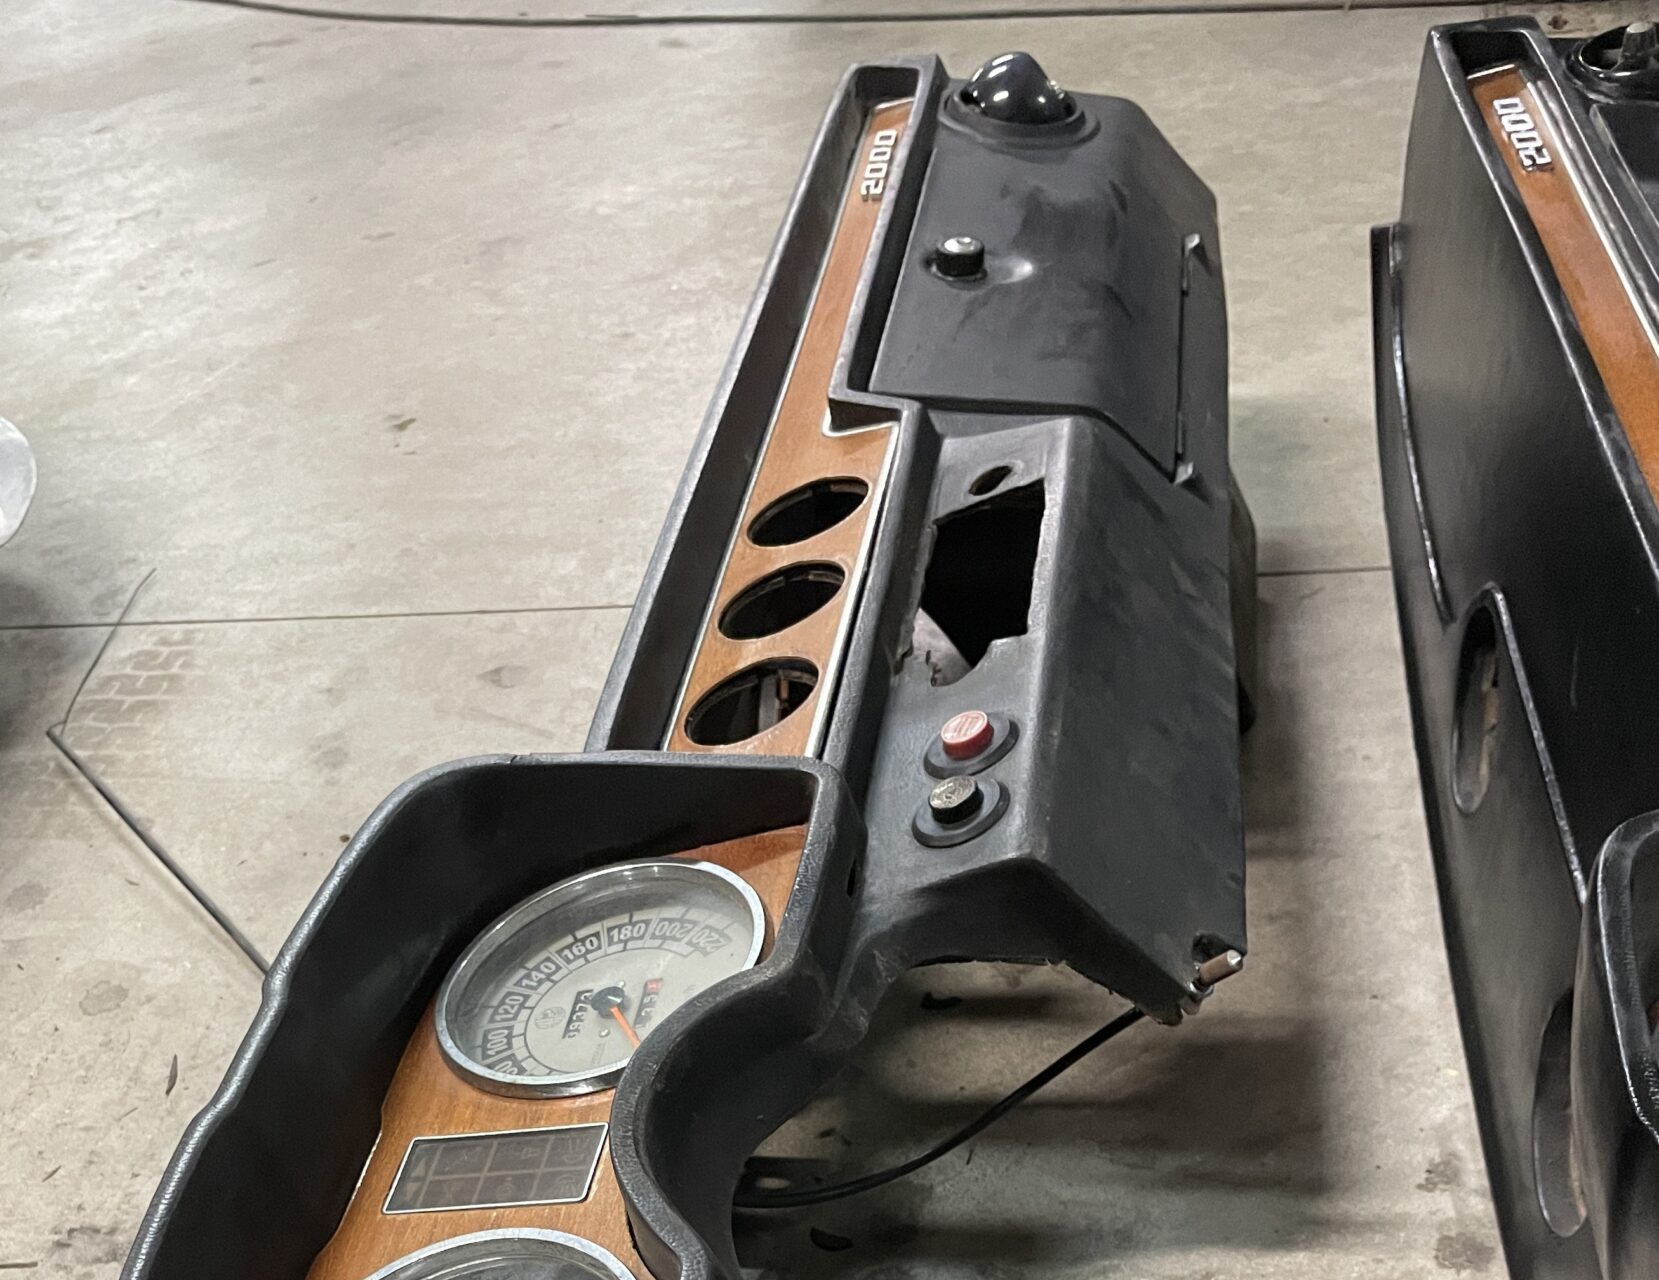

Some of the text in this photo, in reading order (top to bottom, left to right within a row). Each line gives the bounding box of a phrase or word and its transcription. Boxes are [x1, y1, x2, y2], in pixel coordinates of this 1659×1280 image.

[1492, 96, 1552, 169] 2000
[860, 129, 897, 199] 2000
[610, 922, 646, 942] 180
[654, 921, 695, 939] 200
[692, 928, 730, 952] 220
[561, 936, 599, 960] 160
[521, 962, 556, 987] 140
[494, 995, 524, 1021] 120
[486, 1029, 509, 1055] 100
